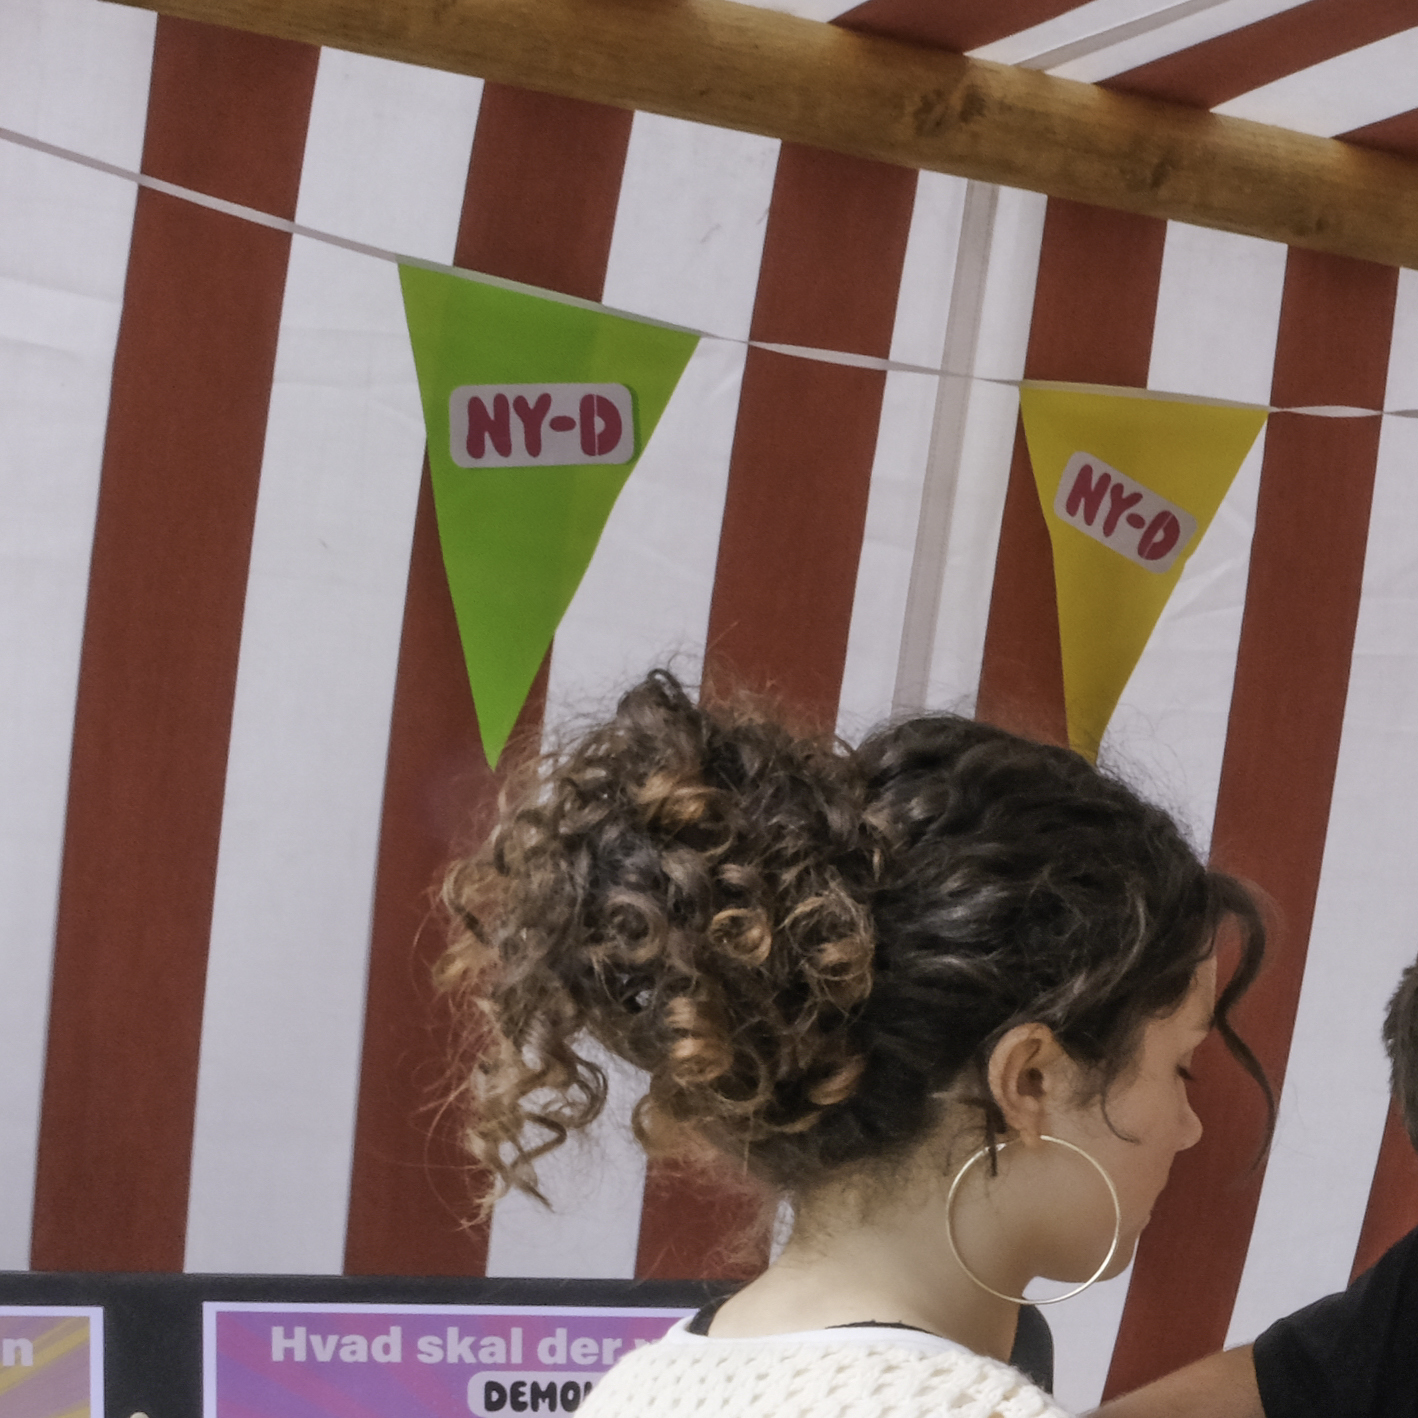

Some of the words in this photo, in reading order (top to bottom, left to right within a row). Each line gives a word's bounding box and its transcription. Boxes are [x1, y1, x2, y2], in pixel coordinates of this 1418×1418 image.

[466, 393, 622, 460] NY-D
[1065, 463, 1182, 562] NY-D
[271, 1325, 402, 1363] Hvad
[417, 1326, 523, 1364] skal
[537, 1328, 622, 1366] der
